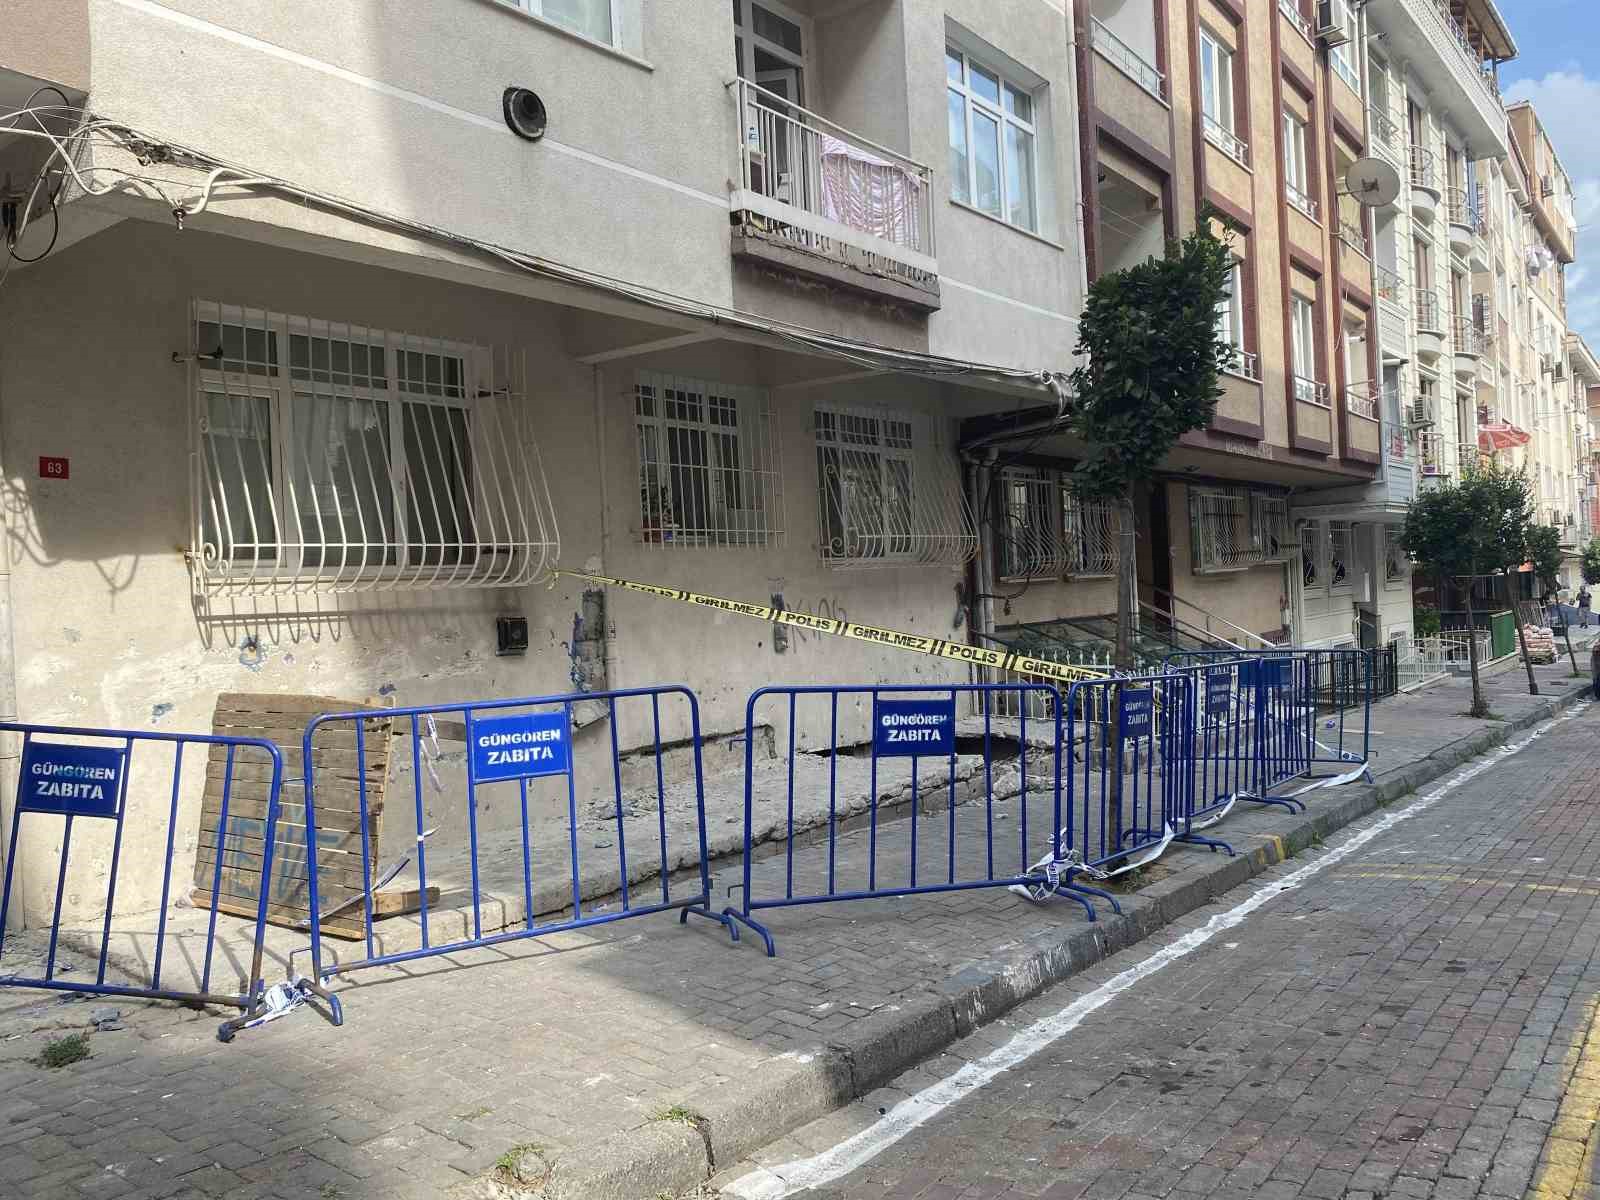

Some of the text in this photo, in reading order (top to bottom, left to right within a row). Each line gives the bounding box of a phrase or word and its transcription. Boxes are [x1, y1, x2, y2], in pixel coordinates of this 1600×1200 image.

[887, 729, 942, 742] ZABITA
[487, 746, 554, 765] ZABITA
[36, 780, 104, 800] ZABITA
